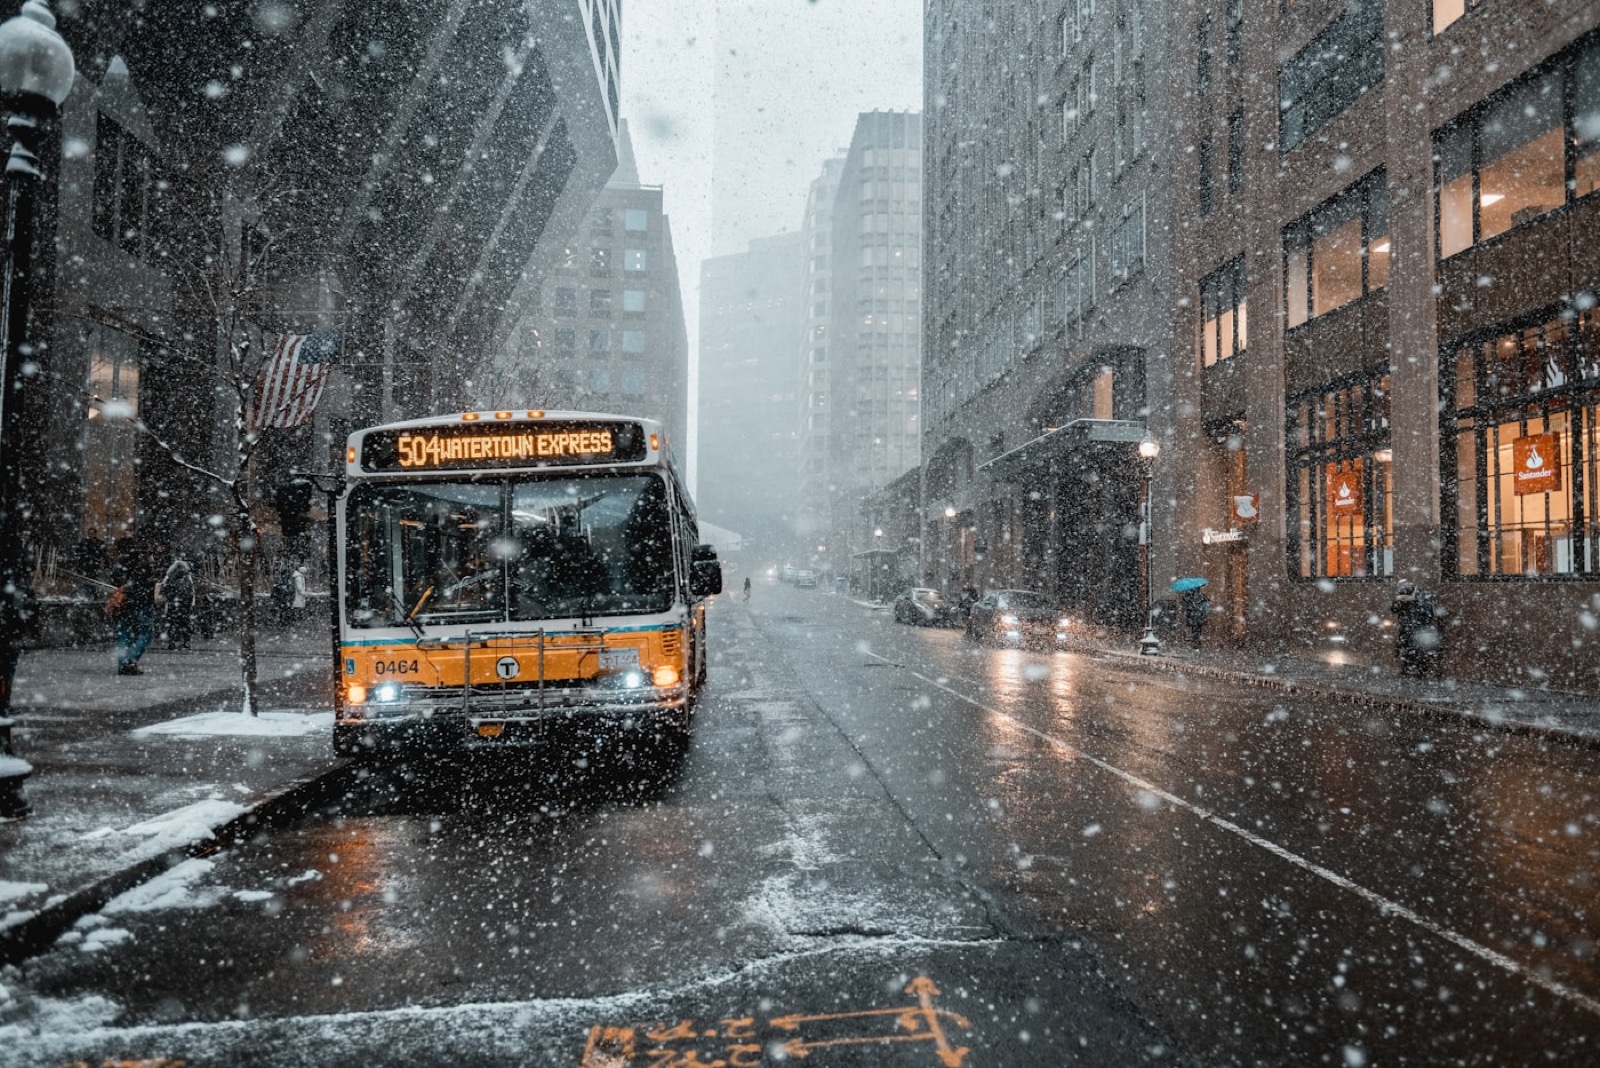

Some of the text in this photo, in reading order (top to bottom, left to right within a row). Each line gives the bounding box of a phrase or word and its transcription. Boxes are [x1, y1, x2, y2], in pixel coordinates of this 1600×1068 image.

[398, 431, 612, 467] 504 WATERTOWN EXPRESS
[1518, 468, 1551, 480] Santander
[375, 660, 419, 675] 0464
